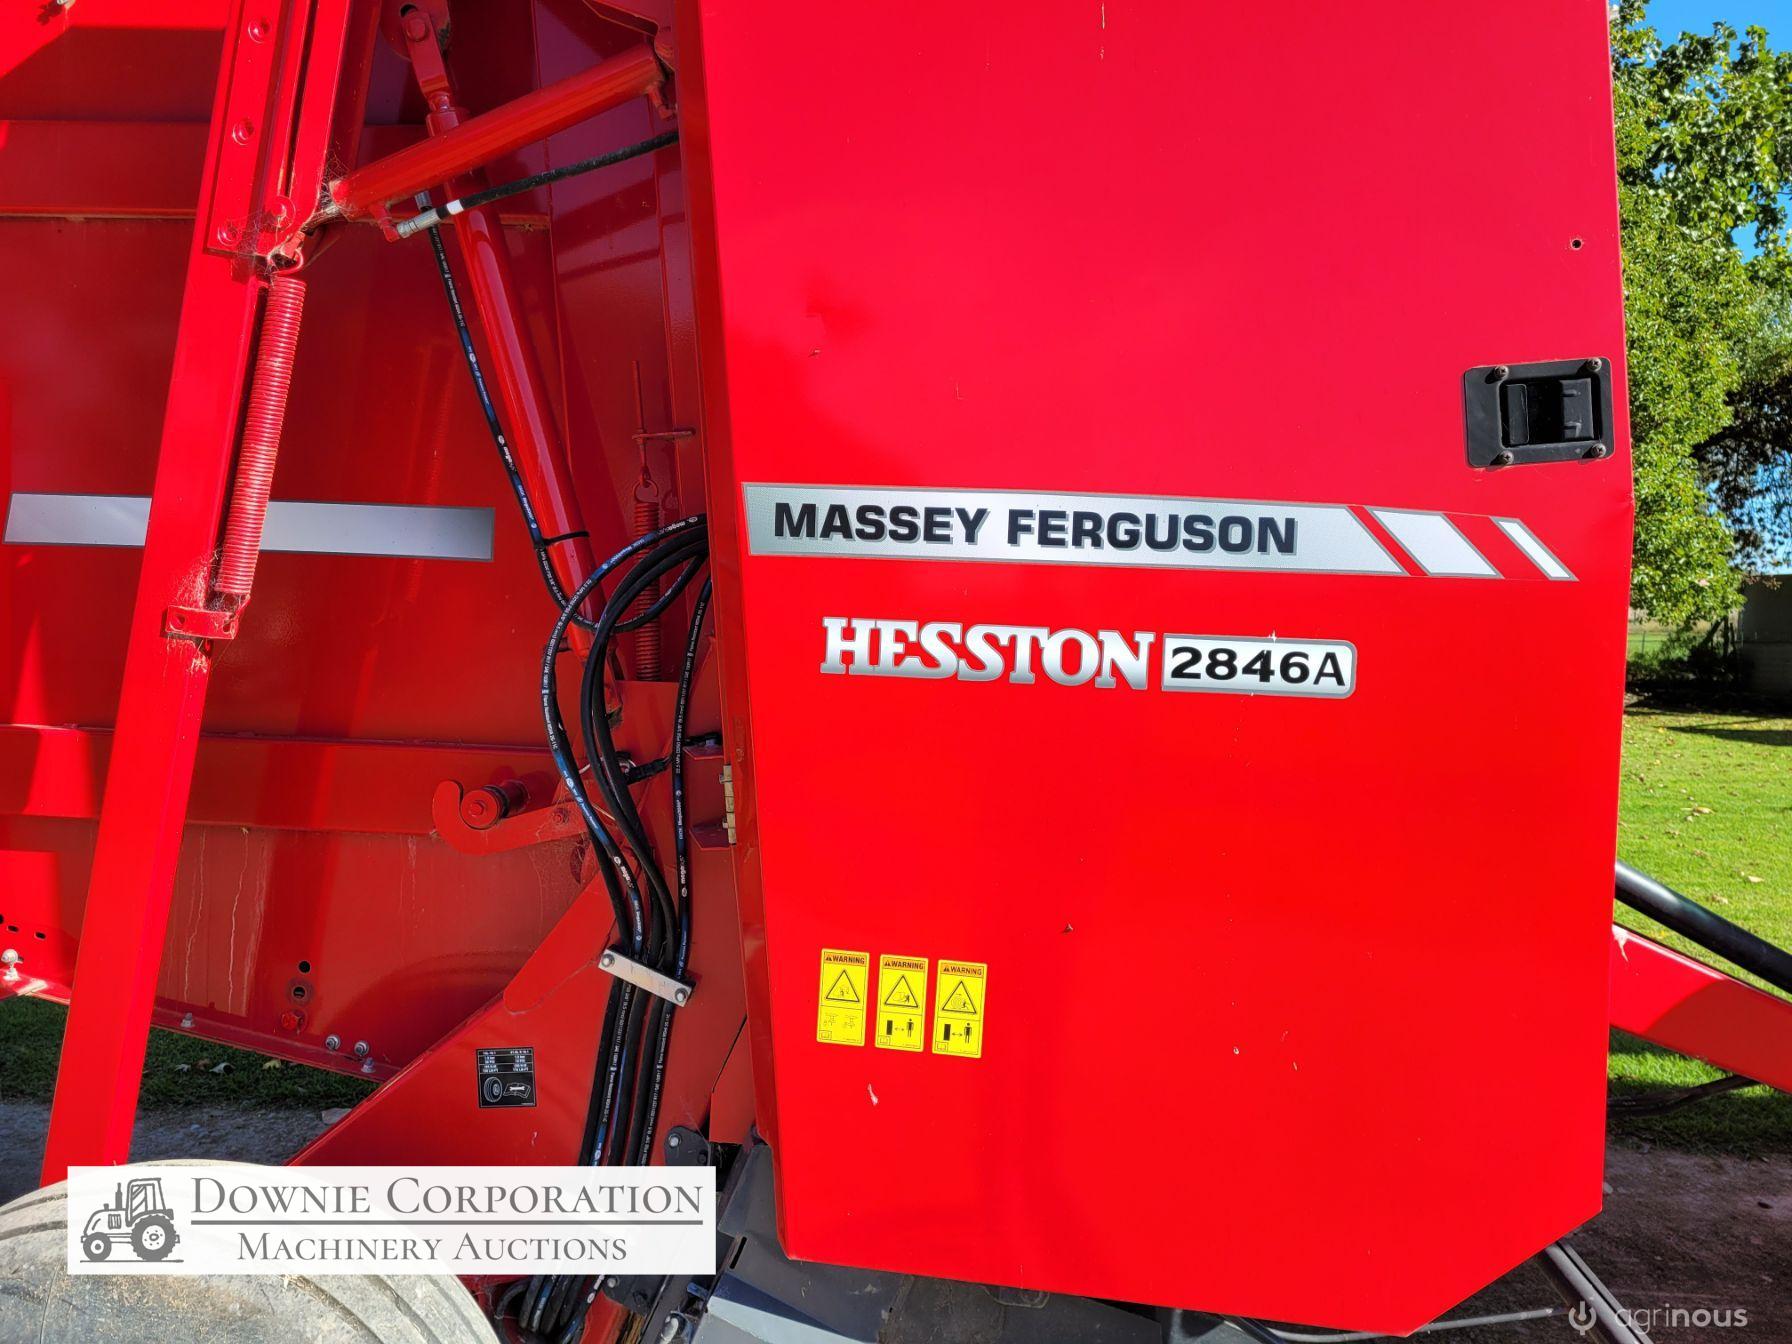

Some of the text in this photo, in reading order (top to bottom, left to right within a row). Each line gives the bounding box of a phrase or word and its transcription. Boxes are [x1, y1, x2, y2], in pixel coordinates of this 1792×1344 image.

[774, 502, 1298, 555] MASSEY FERGUSON
[820, 617, 1156, 690] HESSTON
[1170, 645, 1348, 688] 2846A
[832, 955, 865, 965] WARNING
[891, 960, 924, 970] WARNING
[950, 966, 982, 976] WARNING
